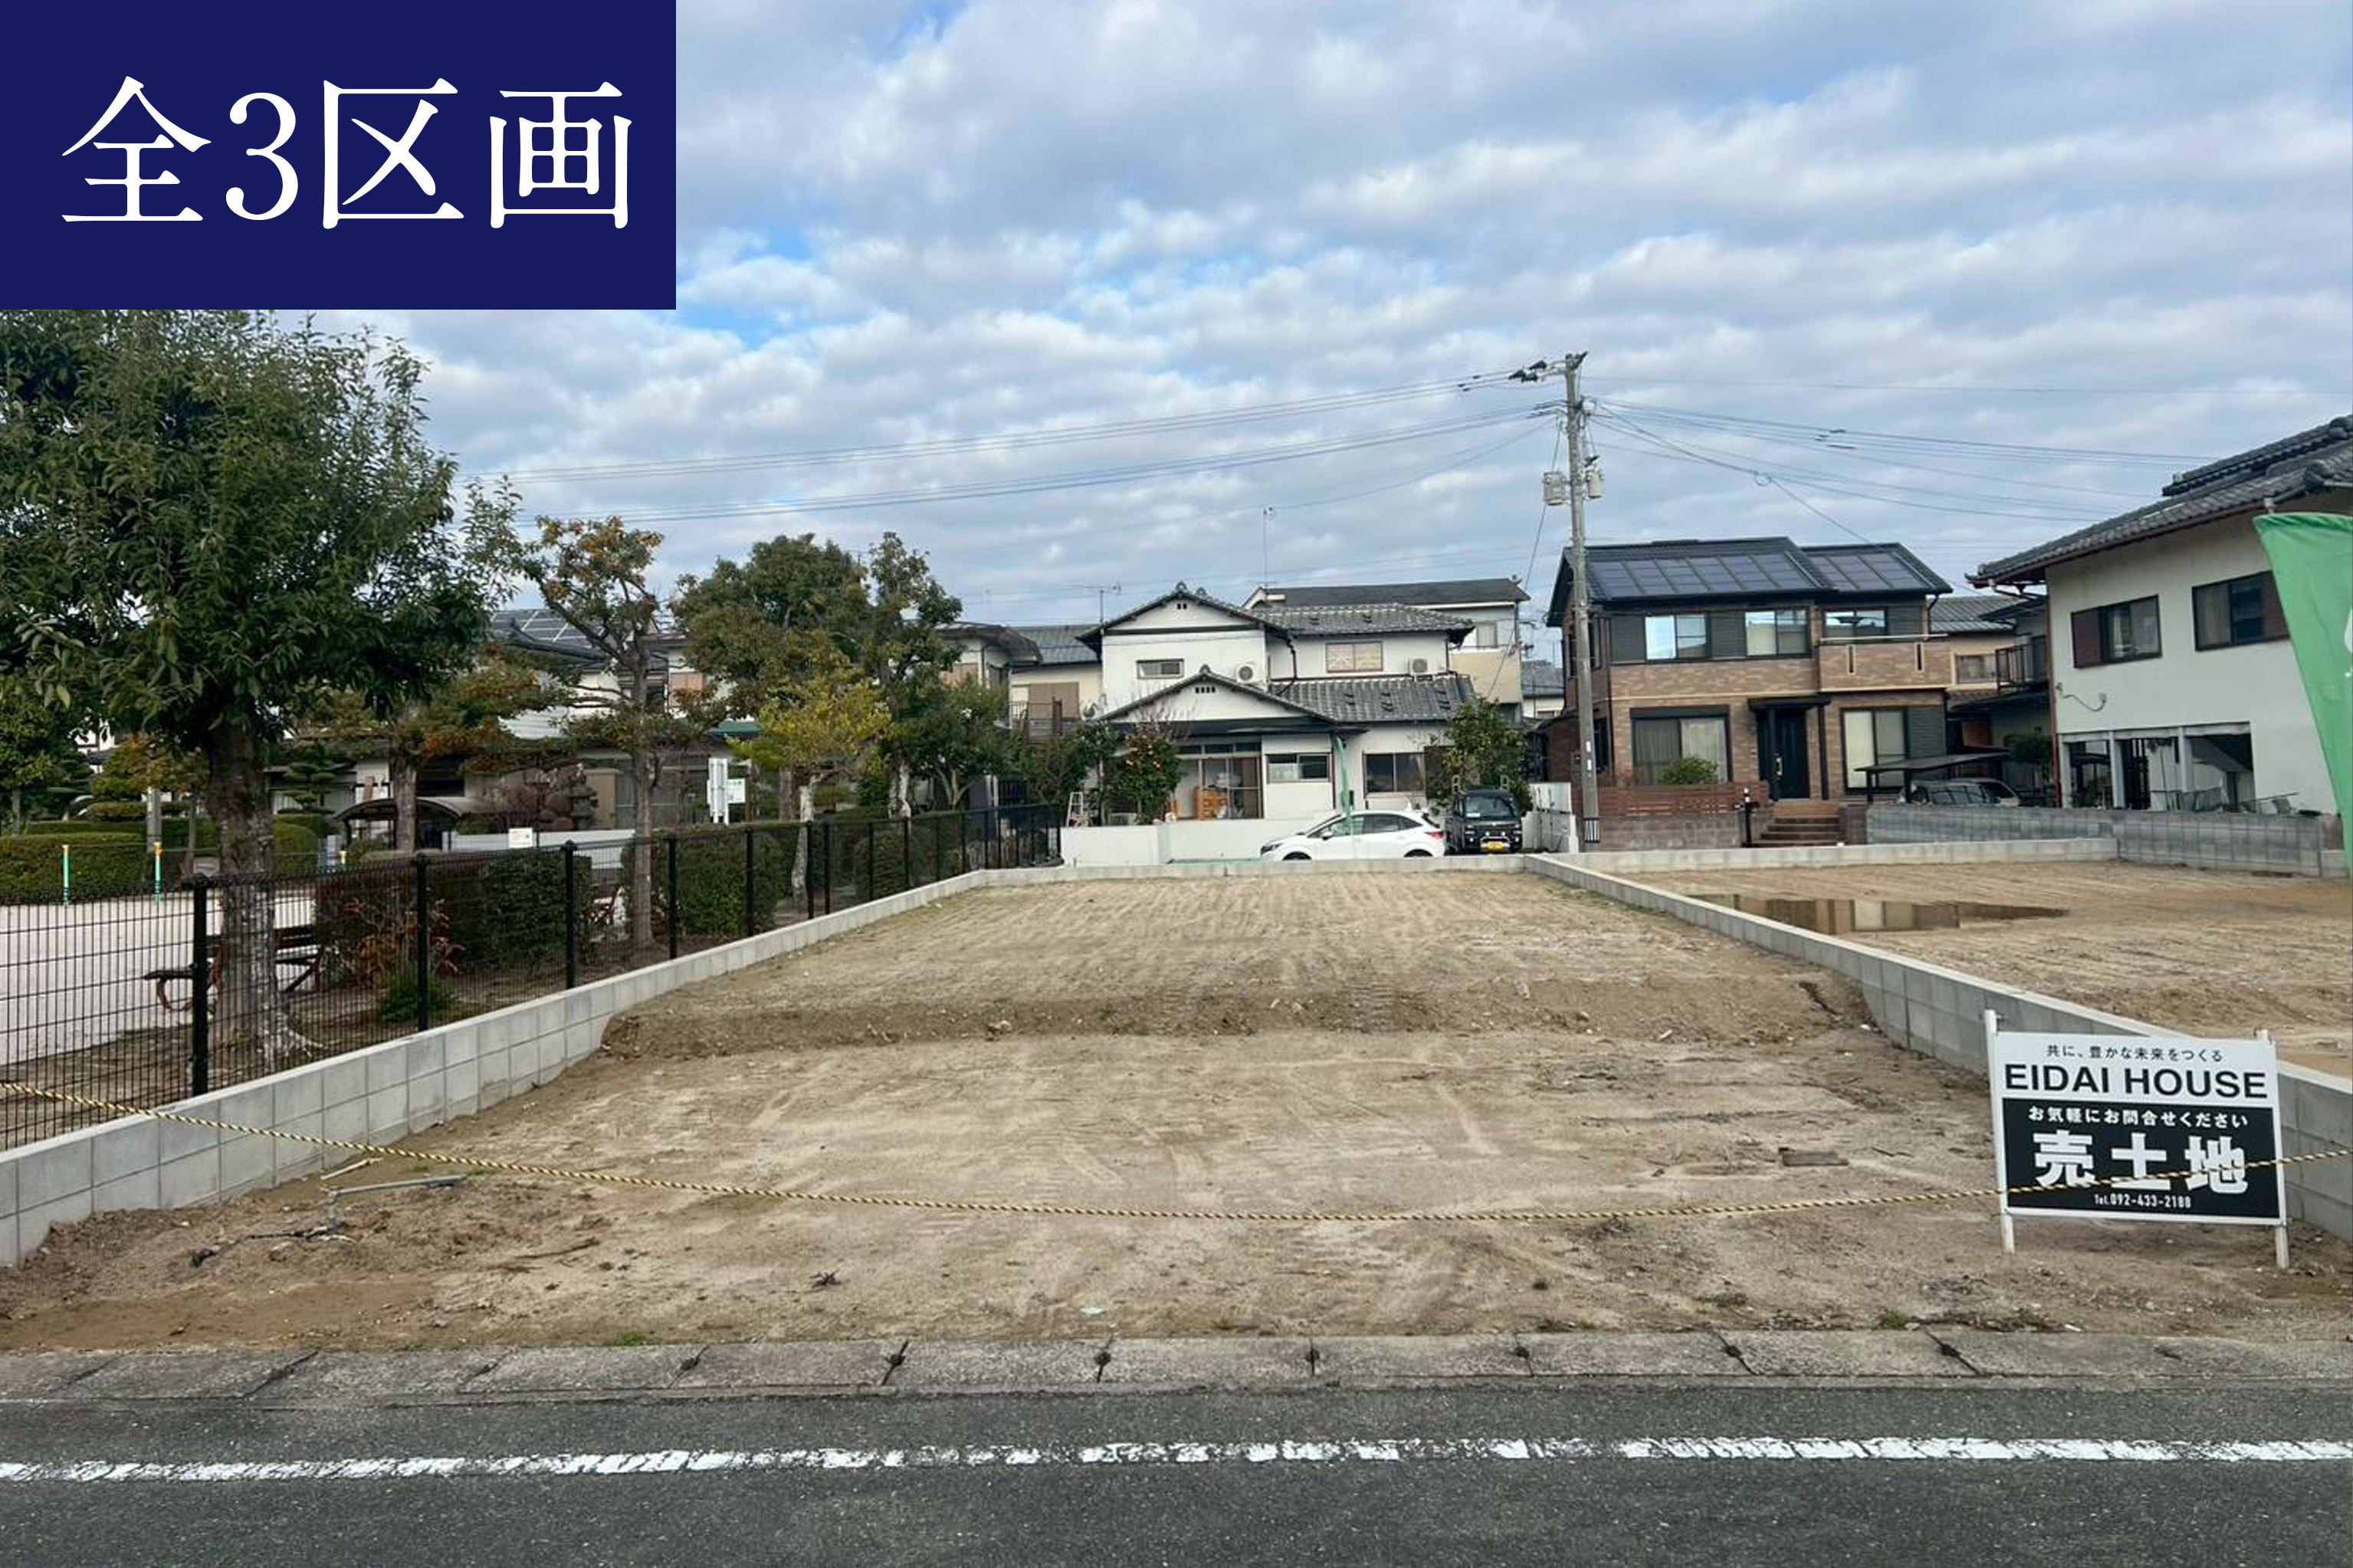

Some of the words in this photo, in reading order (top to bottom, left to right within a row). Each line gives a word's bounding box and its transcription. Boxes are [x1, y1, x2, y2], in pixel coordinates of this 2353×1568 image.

[2046, 1044, 2223, 1062] 共に、豊かな未来をつくる
[2005, 1064, 2110, 1093] EIDAI
[2124, 1068, 2267, 1098] HOUSE
[2028, 1106, 2249, 1129] お気軽にお問合せください
[2033, 1130, 2250, 1195] 売土地
